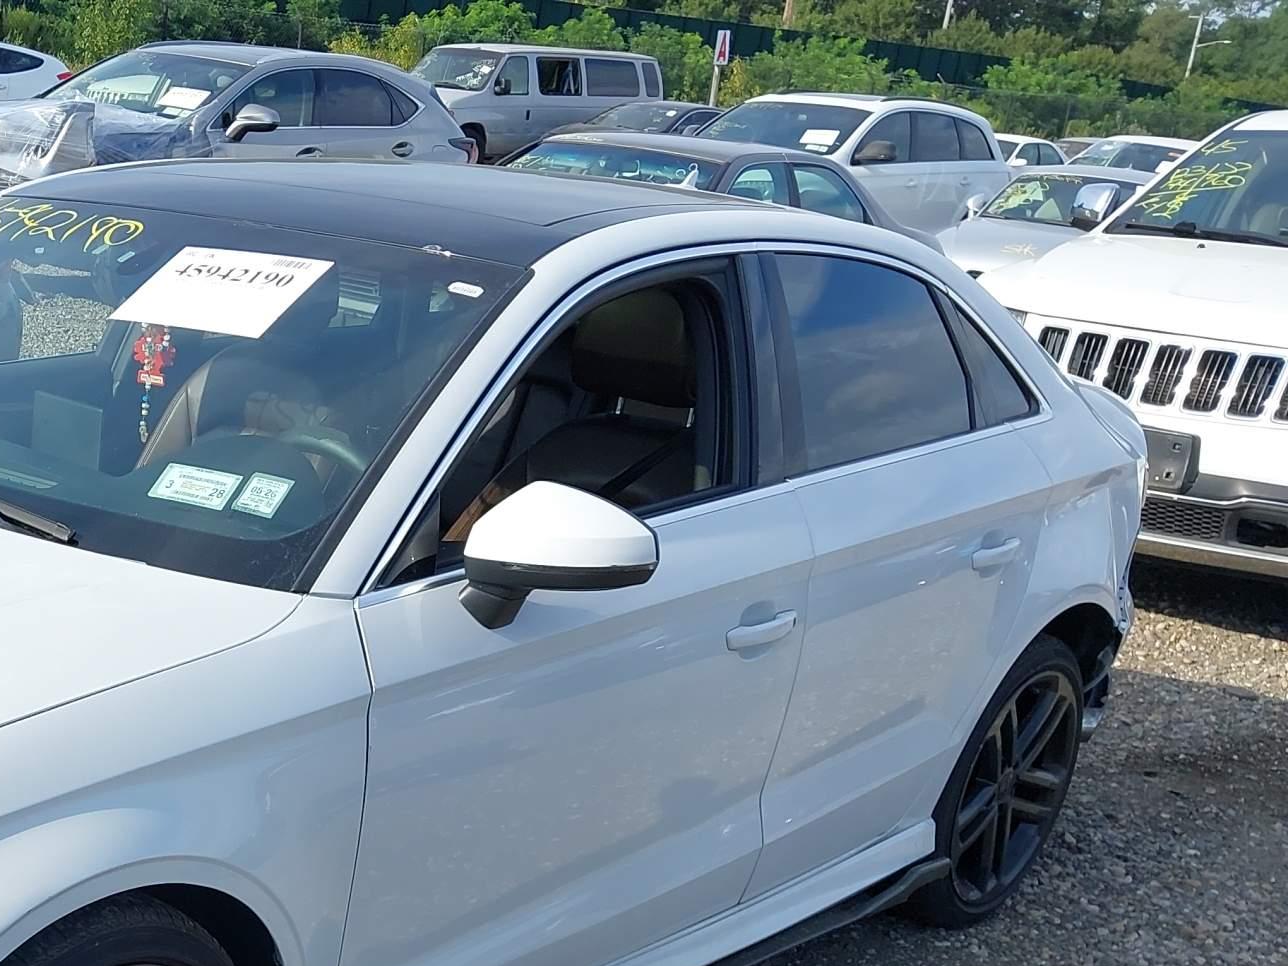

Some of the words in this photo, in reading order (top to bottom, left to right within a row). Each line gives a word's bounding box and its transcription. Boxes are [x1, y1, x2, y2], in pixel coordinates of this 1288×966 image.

[716, 31, 727, 62] A
[176, 263, 295, 288] 45942190
[208, 487, 225, 499] 28
